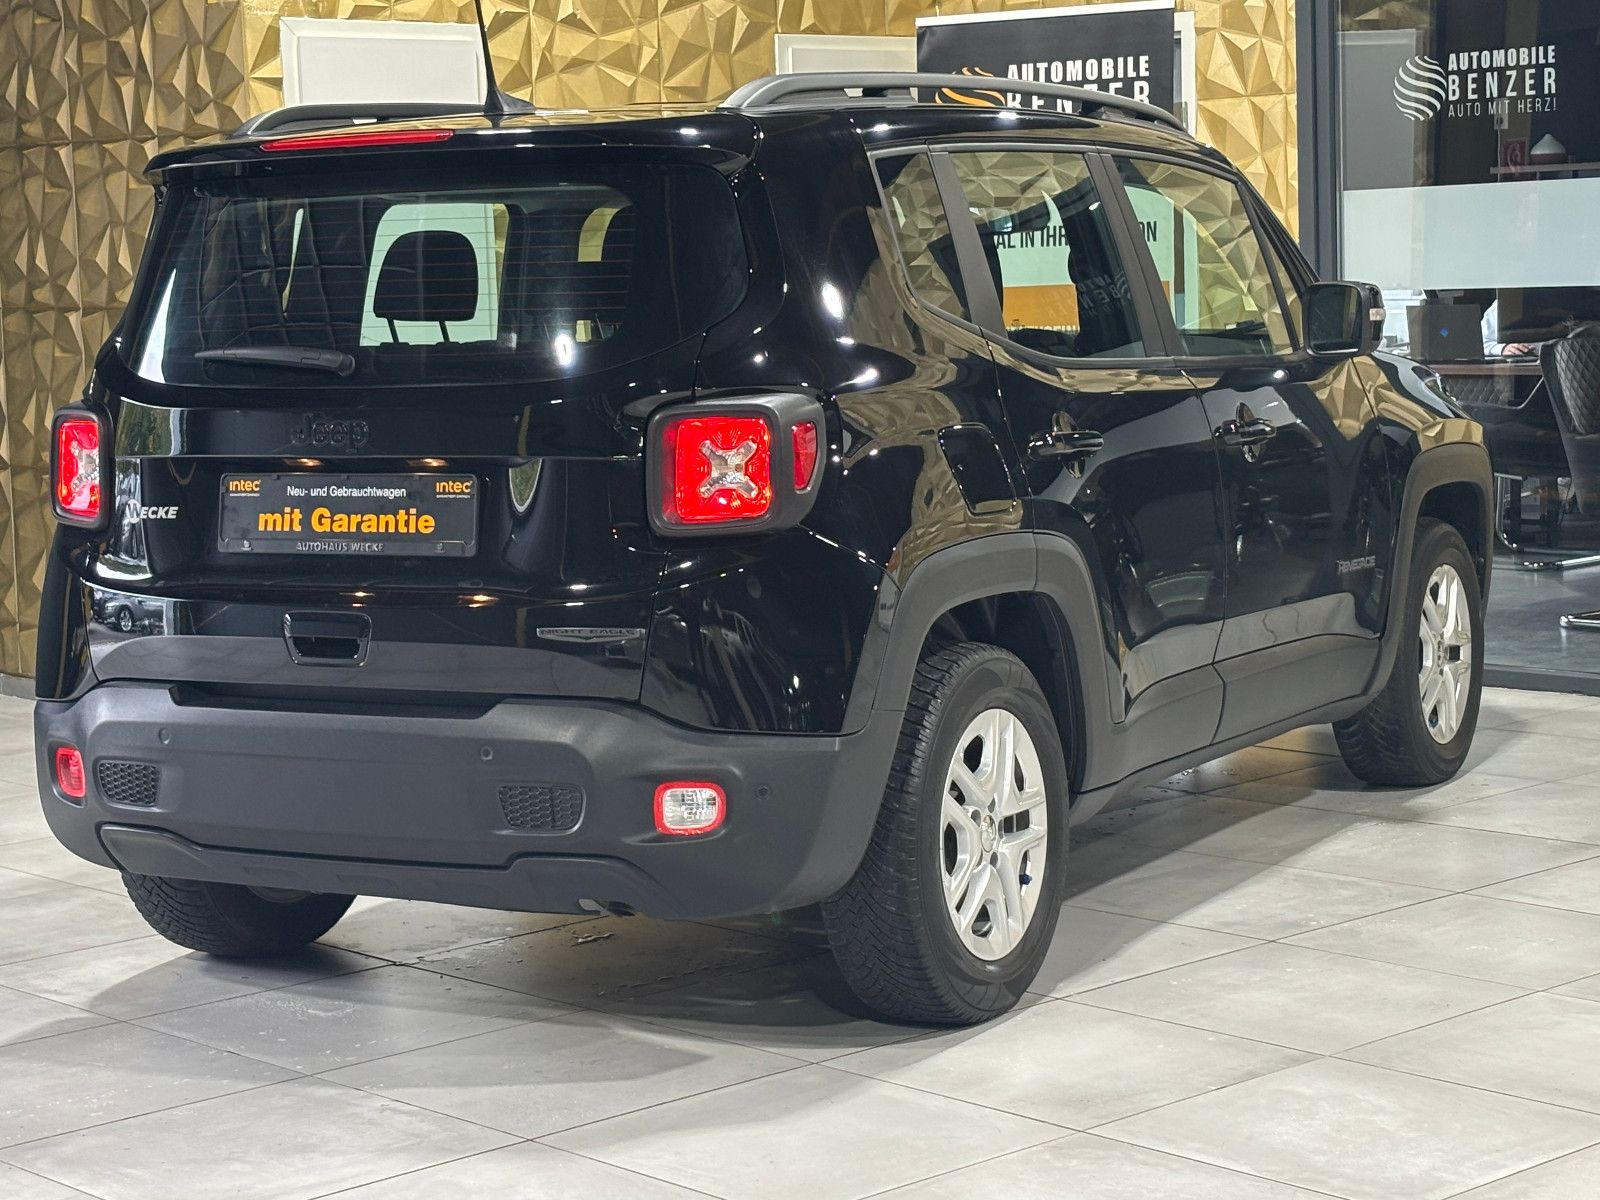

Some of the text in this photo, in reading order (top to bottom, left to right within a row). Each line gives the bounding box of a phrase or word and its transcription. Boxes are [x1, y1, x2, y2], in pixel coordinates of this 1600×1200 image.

[1448, 45, 1555, 71] AUTOMOBILE
[1007, 55, 1150, 83] AUTOMOBILE
[1448, 67, 1556, 101] BENZER
[1448, 97, 1557, 118] AUTO MIT HERZ!
[1020, 231, 1034, 248] IN
[229, 479, 261, 491] intec
[287, 486, 407, 500] Neu- und Gebrauchtwagen
[436, 480, 472, 492] intec
[258, 507, 436, 534] mit Garantie
[296, 542, 384, 552] AUTOHAUS WECKE
